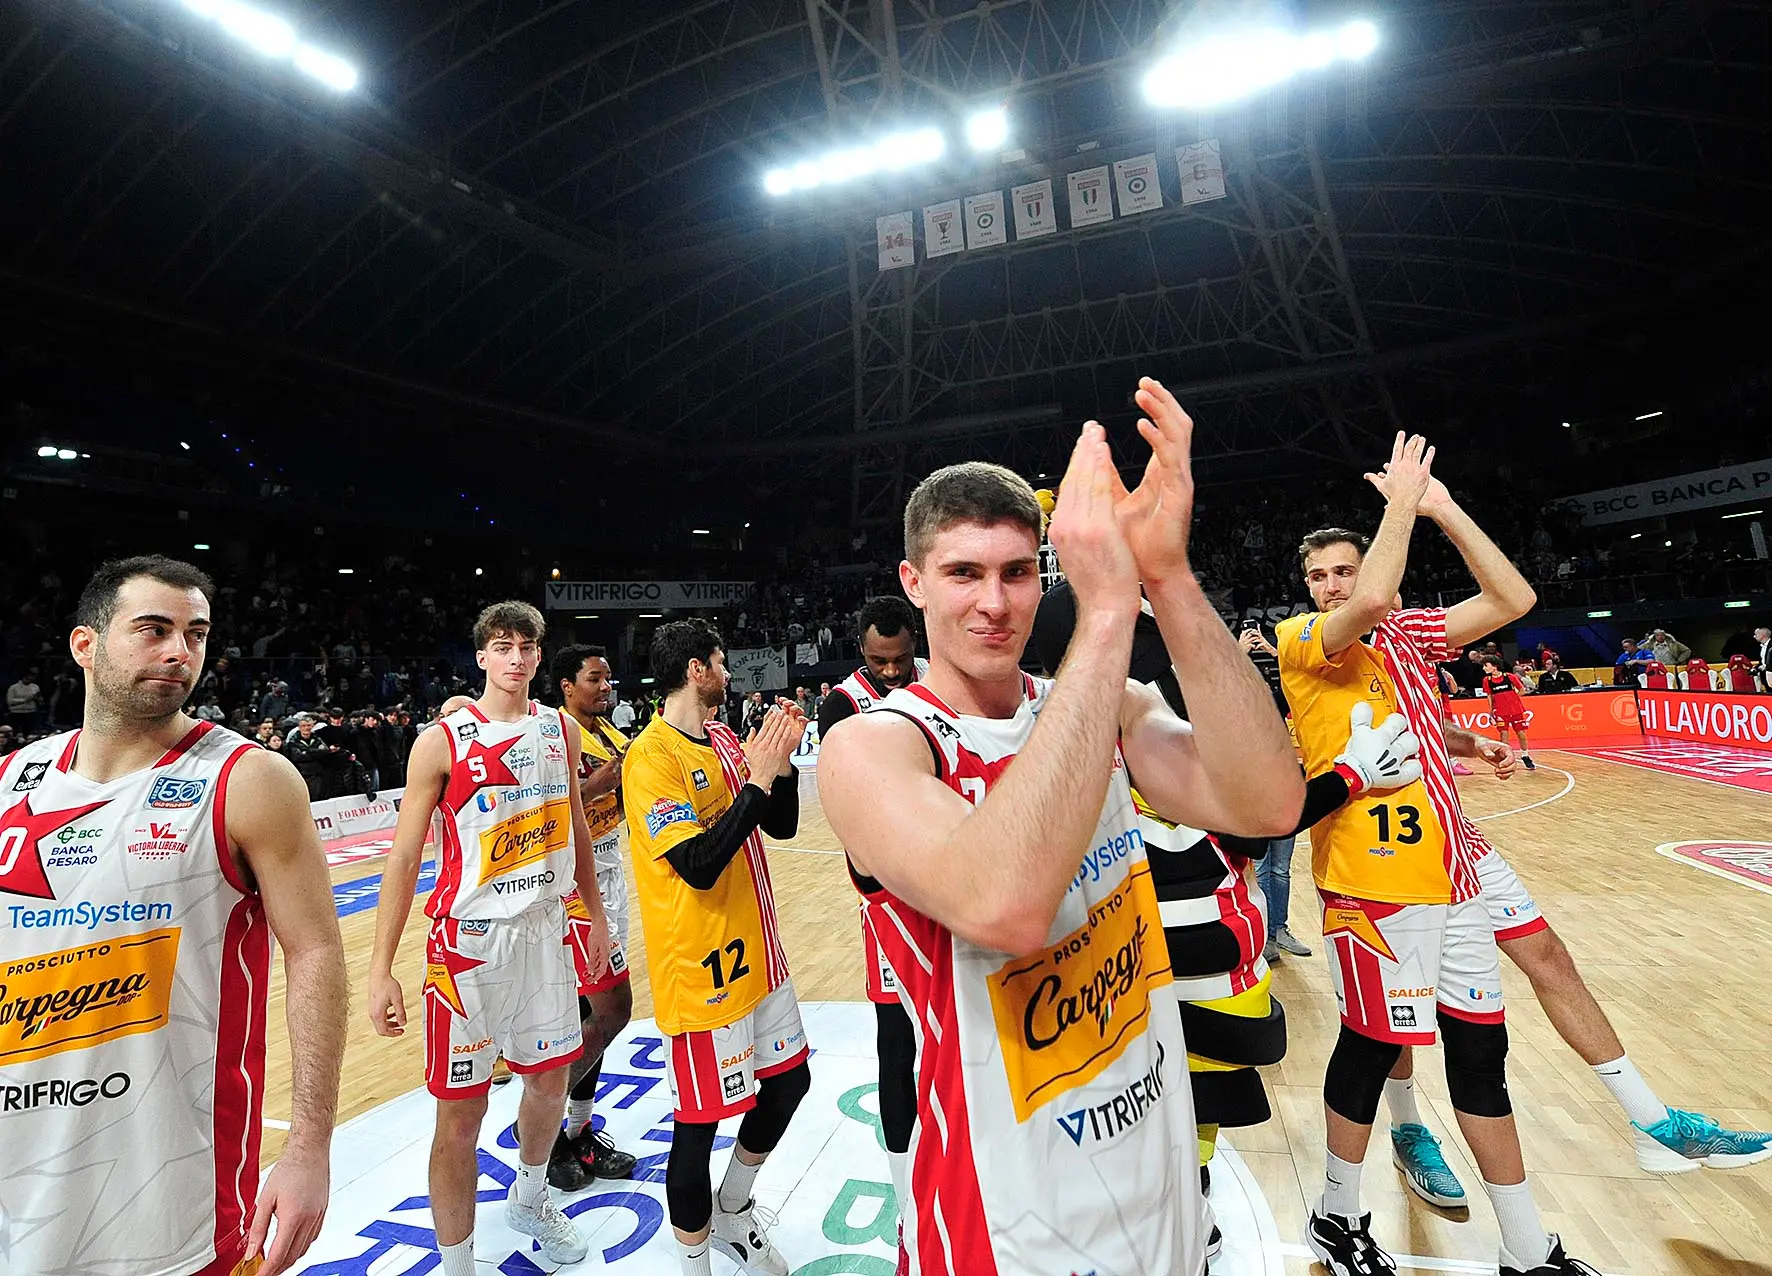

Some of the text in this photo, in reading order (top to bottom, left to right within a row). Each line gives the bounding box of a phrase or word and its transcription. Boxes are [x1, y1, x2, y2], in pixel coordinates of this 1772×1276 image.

[1592, 471, 1772, 515] BCC BANCA P
[548, 583, 661, 600] VITRIFRIGO
[1664, 700, 1772, 743] LAVORO
[467, 755, 488, 783] 5
[337, 803, 391, 819] FORMETAL
[650, 808, 692, 834] SPORT
[78, 828, 103, 838] BCC
[1368, 804, 1423, 844] 13
[51, 845, 93, 856] BANCA
[127, 841, 189, 854] VICTORIA LIBERTAS
[47, 855, 98, 867] PESARO
[8, 901, 172, 930] TeamSystem
[7, 945, 111, 976] PROSCIUTTO
[701, 938, 750, 990] 12
[0, 973, 150, 1032] arpegna
[1389, 987, 1435, 998] SALICE
[453, 1073, 473, 1082] errea
[727, 1086, 747, 1098] errea
